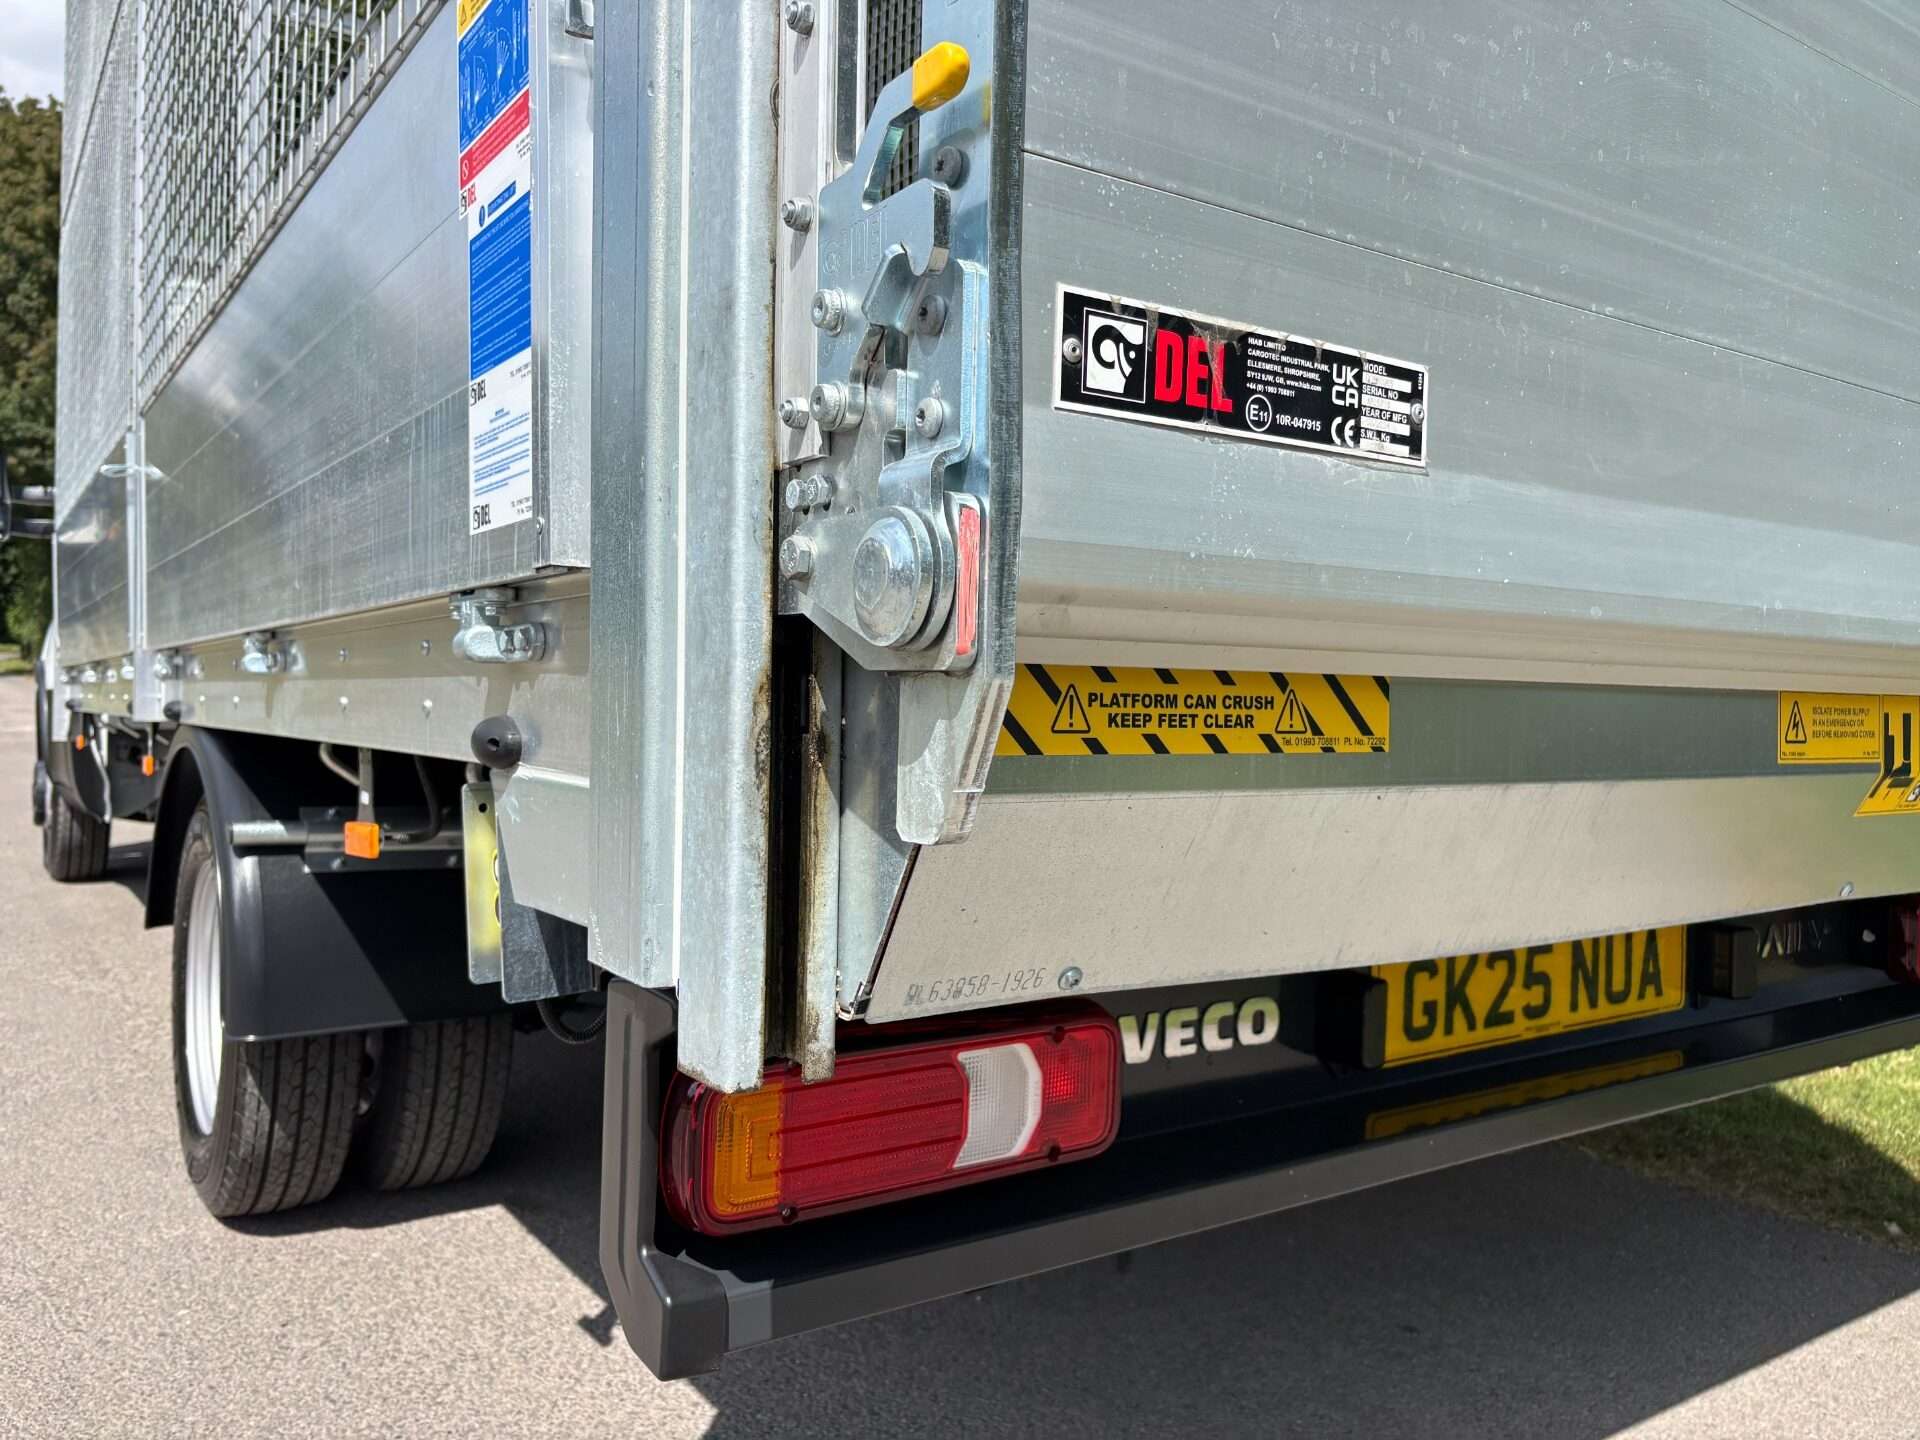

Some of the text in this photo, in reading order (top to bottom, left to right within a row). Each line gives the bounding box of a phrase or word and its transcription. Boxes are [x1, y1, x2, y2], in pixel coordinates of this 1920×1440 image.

[1248, 337, 1263, 347] HIAB
[1247, 348, 1280, 361] CARGOTEC
[1280, 355, 1314, 369] INDUSTRIAL
[1154, 328, 1233, 413] DEL
[1332, 363, 1360, 388] UK
[1362, 361, 1388, 376] MODEL
[1331, 384, 1359, 409] CA
[1362, 384, 1399, 400] SERIAL NO
[1275, 413, 1322, 432] 10R-047915
[1361, 406, 1408, 424] YEAR OF MFG
[1330, 416, 1356, 448] CE
[1088, 692, 1275, 711] PLATFORM CAN CRUSH
[1107, 712, 1255, 729] KEEP FEET CLEAR
[1833, 707, 1852, 716] POWER
[1826, 719, 1856, 728] EMERGENCY
[1294, 737, 1316, 746] 01993
[1812, 729, 1832, 739] BEFORE
[1403, 928, 1664, 1043] GK25 NUA
[1118, 996, 1281, 1065] VECO
